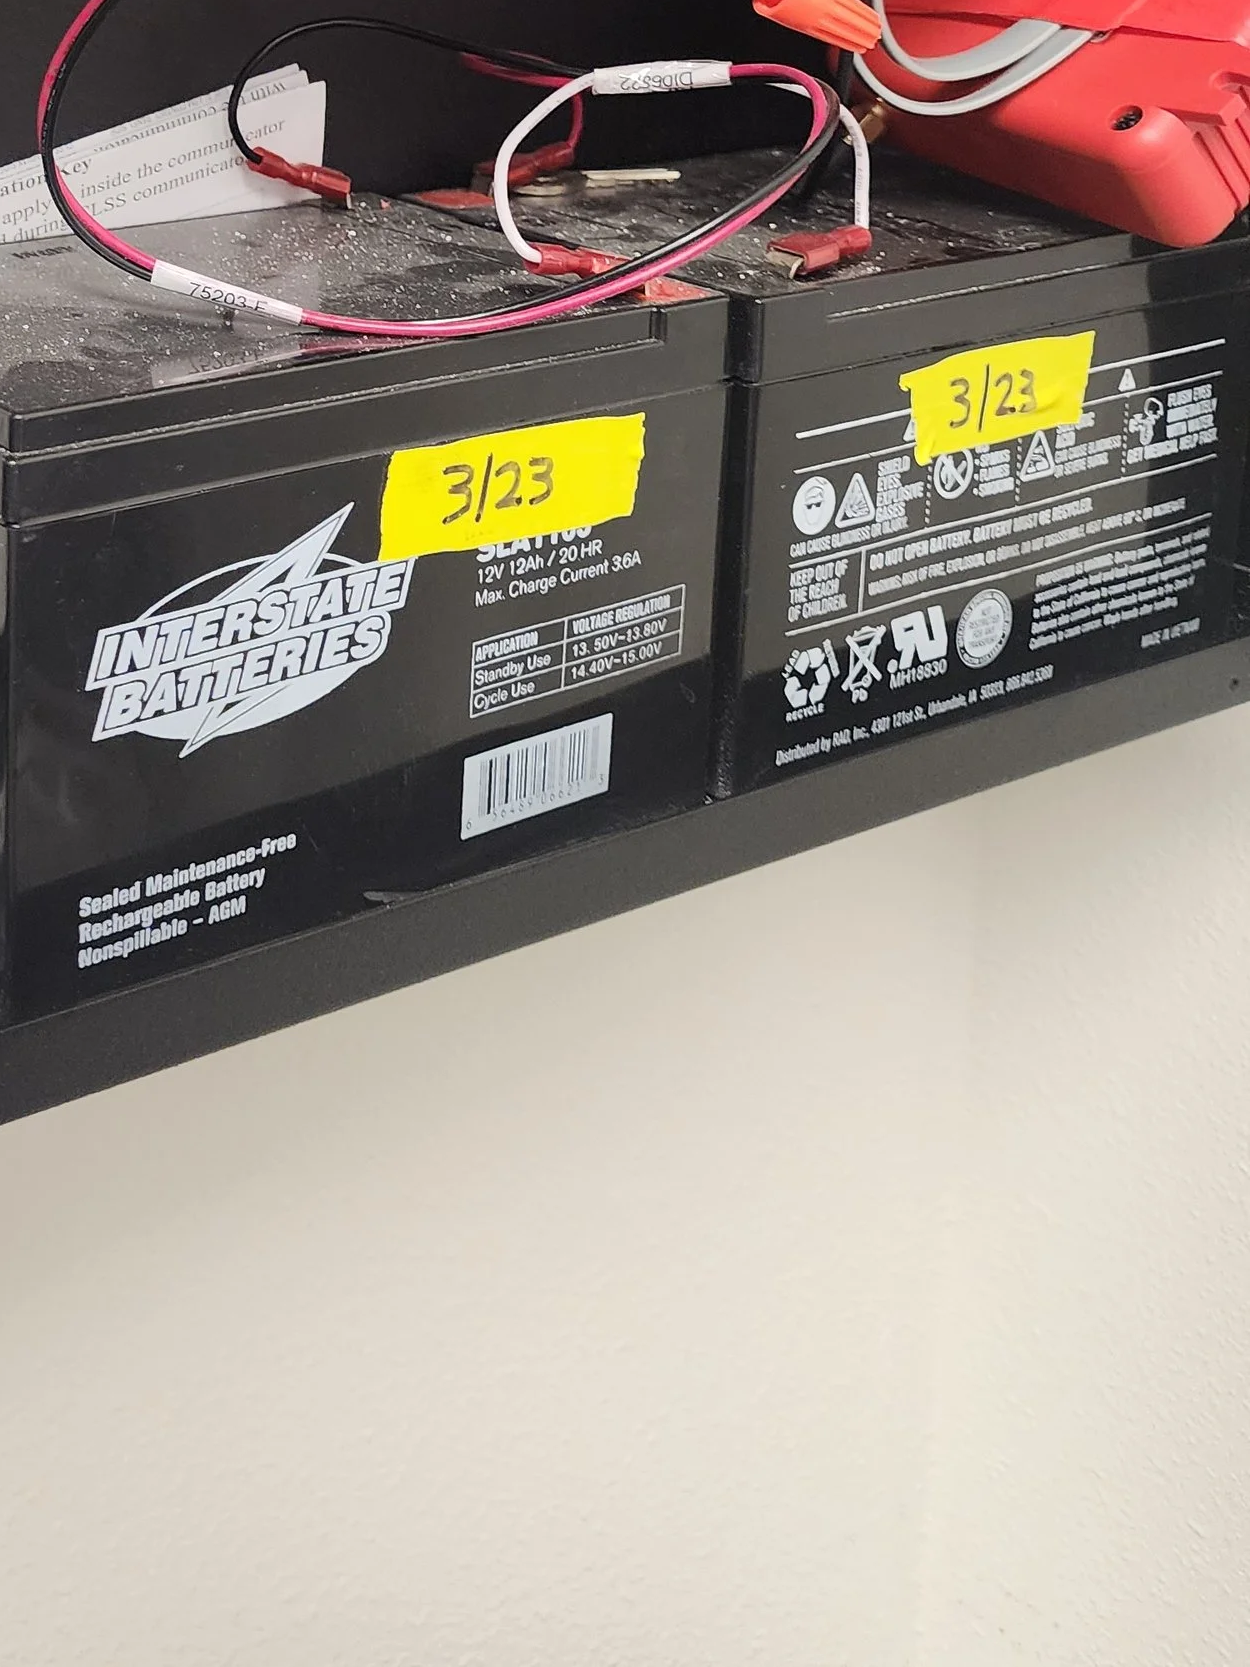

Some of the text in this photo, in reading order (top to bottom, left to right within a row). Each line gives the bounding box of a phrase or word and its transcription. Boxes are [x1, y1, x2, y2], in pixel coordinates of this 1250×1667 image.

[81, 157, 163, 199] inside the
[949, 363, 1037, 433] 3/23
[442, 452, 555, 527] 3/23
[475, 589, 506, 607] Max.
[509, 575, 556, 598] Charge
[560, 561, 608, 585] Current
[478, 539, 602, 584] 12V 12Ah / 20 HR
[95, 560, 408, 683] INTERSTATE
[475, 631, 539, 662] APPLICATION
[101, 615, 386, 732] BATTERIES
[474, 654, 551, 686] Standby Use
[474, 682, 535, 710] Cycle Use
[889, 658, 948, 690] MH18830
[79, 833, 296, 917] Sealed Maintenance-Free
[78, 895, 247, 969] Nonspillable AGM
[79, 867, 265, 943] Rechargeable Battery
